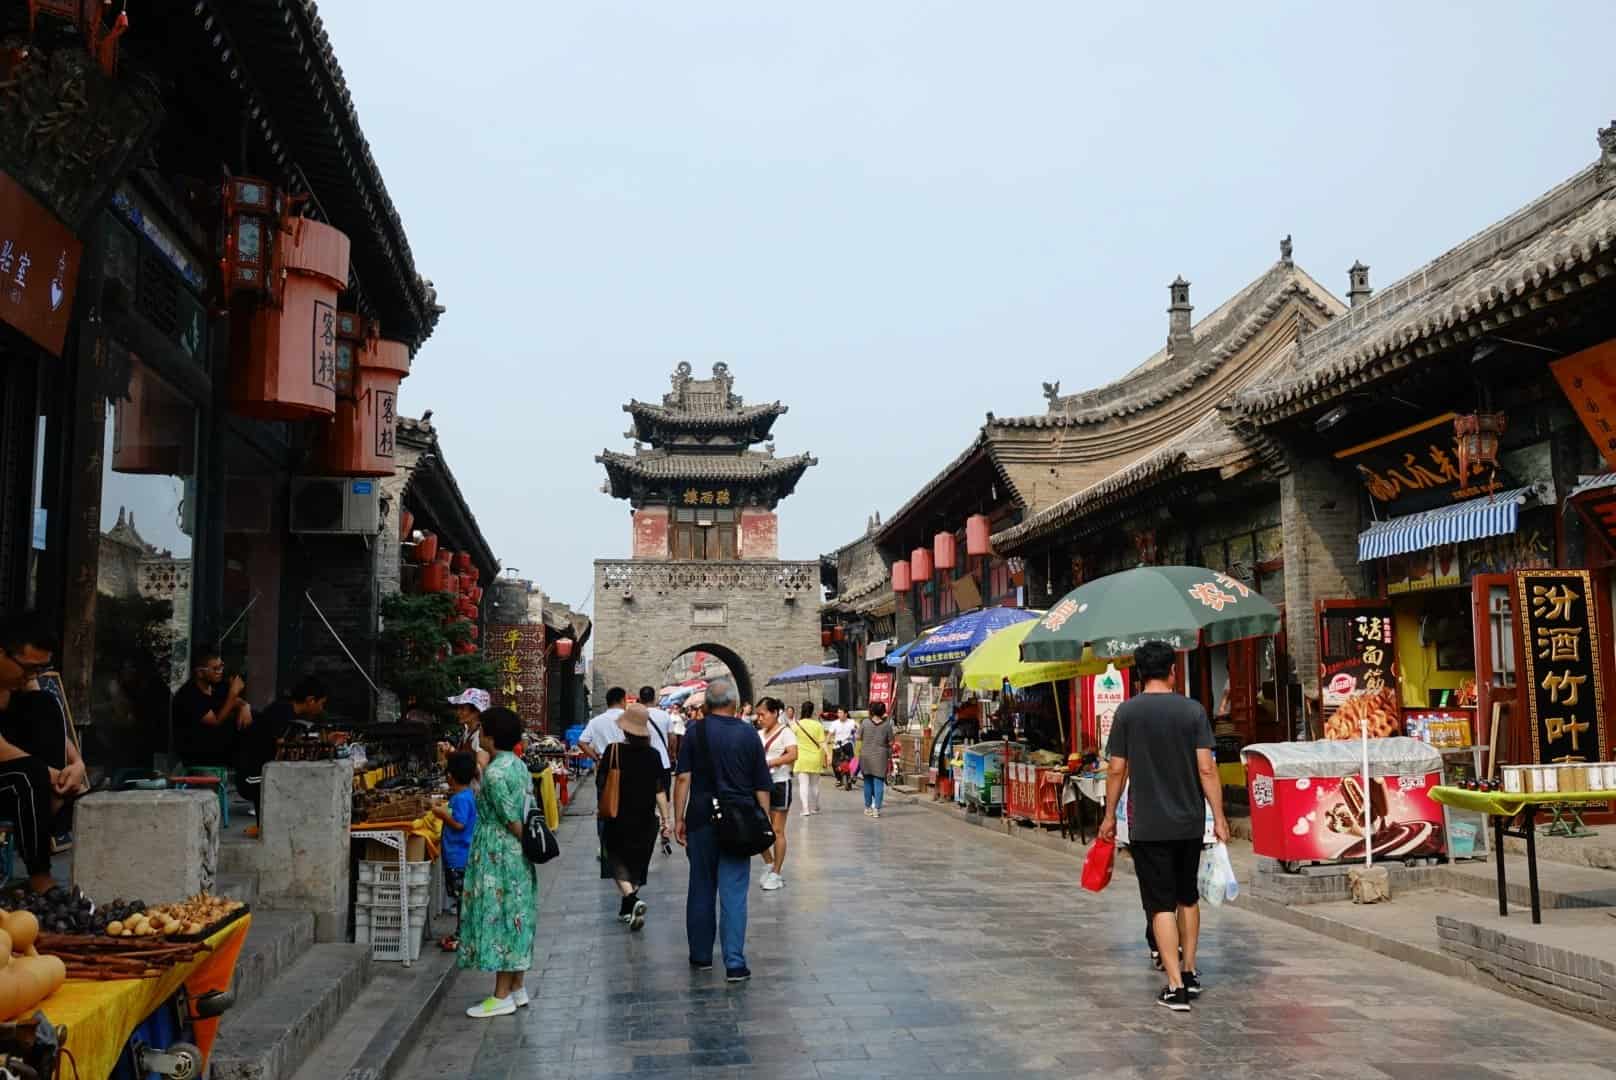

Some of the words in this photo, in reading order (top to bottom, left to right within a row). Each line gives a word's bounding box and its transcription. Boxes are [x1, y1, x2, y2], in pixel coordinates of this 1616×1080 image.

[318, 311, 336, 383] 客栈
[1359, 616, 1385, 694] 烤面筋
[1533, 583, 1590, 763] 汾酒竹叶
